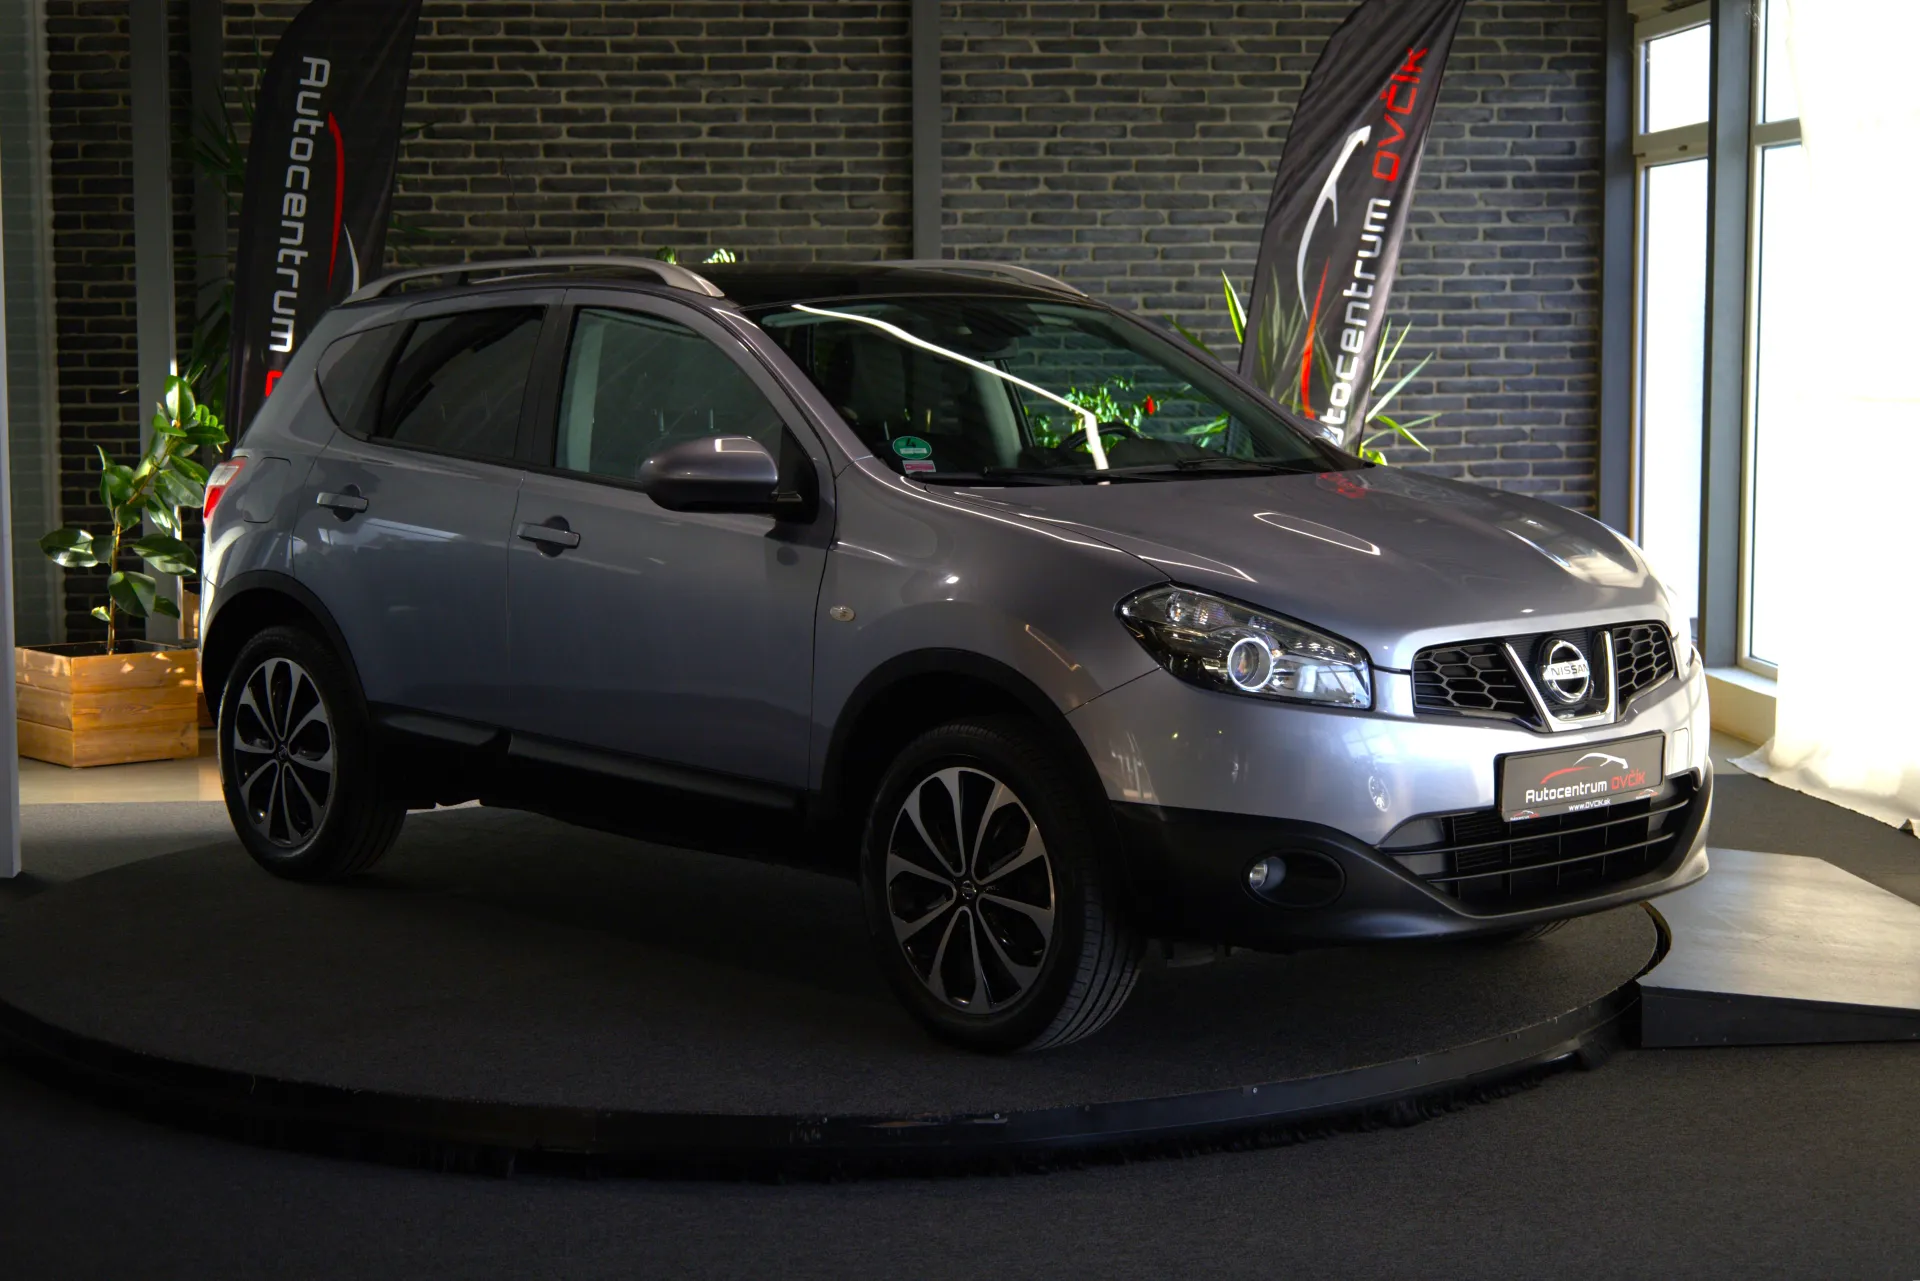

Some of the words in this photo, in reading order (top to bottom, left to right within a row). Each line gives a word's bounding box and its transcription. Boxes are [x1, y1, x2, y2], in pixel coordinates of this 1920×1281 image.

[269, 55, 331, 353] Autocentrum
[1550, 663, 1589, 676] NISSAN
[1525, 780, 1607, 803] Autocentrum
